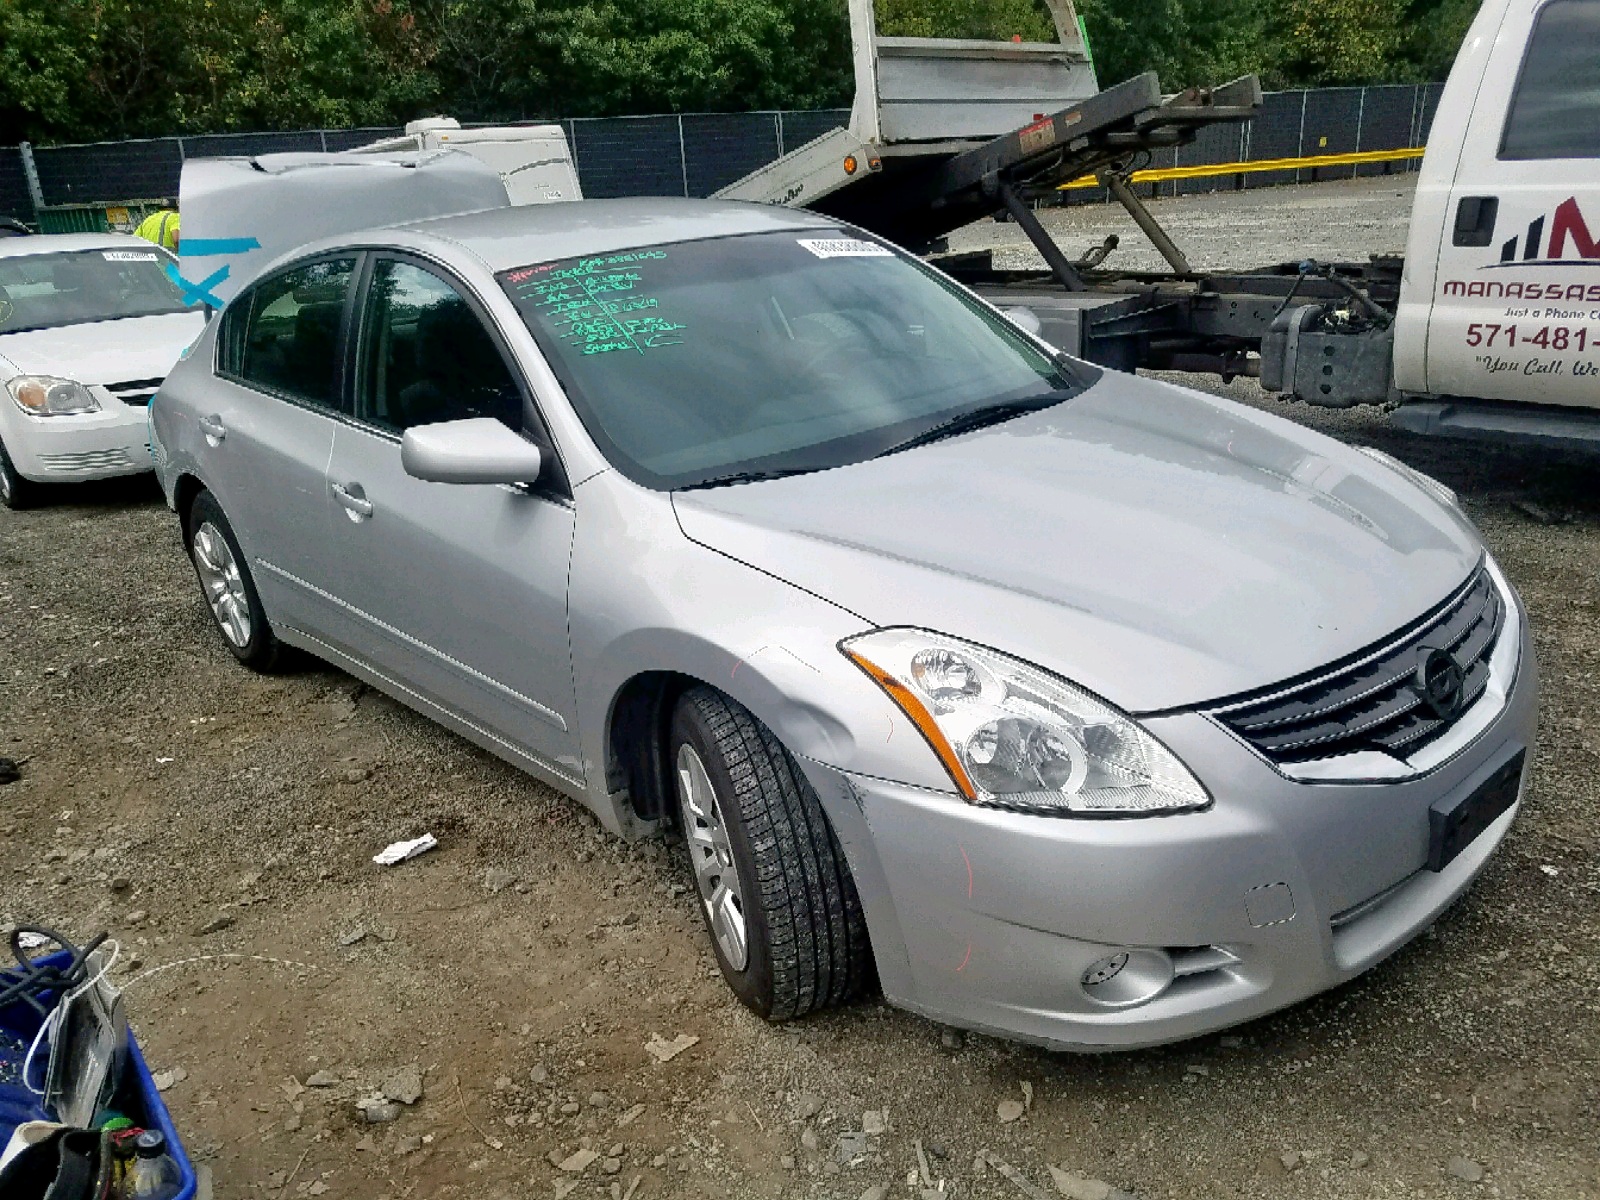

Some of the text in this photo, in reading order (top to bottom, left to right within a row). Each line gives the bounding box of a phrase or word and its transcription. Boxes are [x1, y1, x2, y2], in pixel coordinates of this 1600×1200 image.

[1504, 307, 1529, 318] Just
[1532, 310, 1540, 318] a
[1545, 308, 1585, 319] Phone
